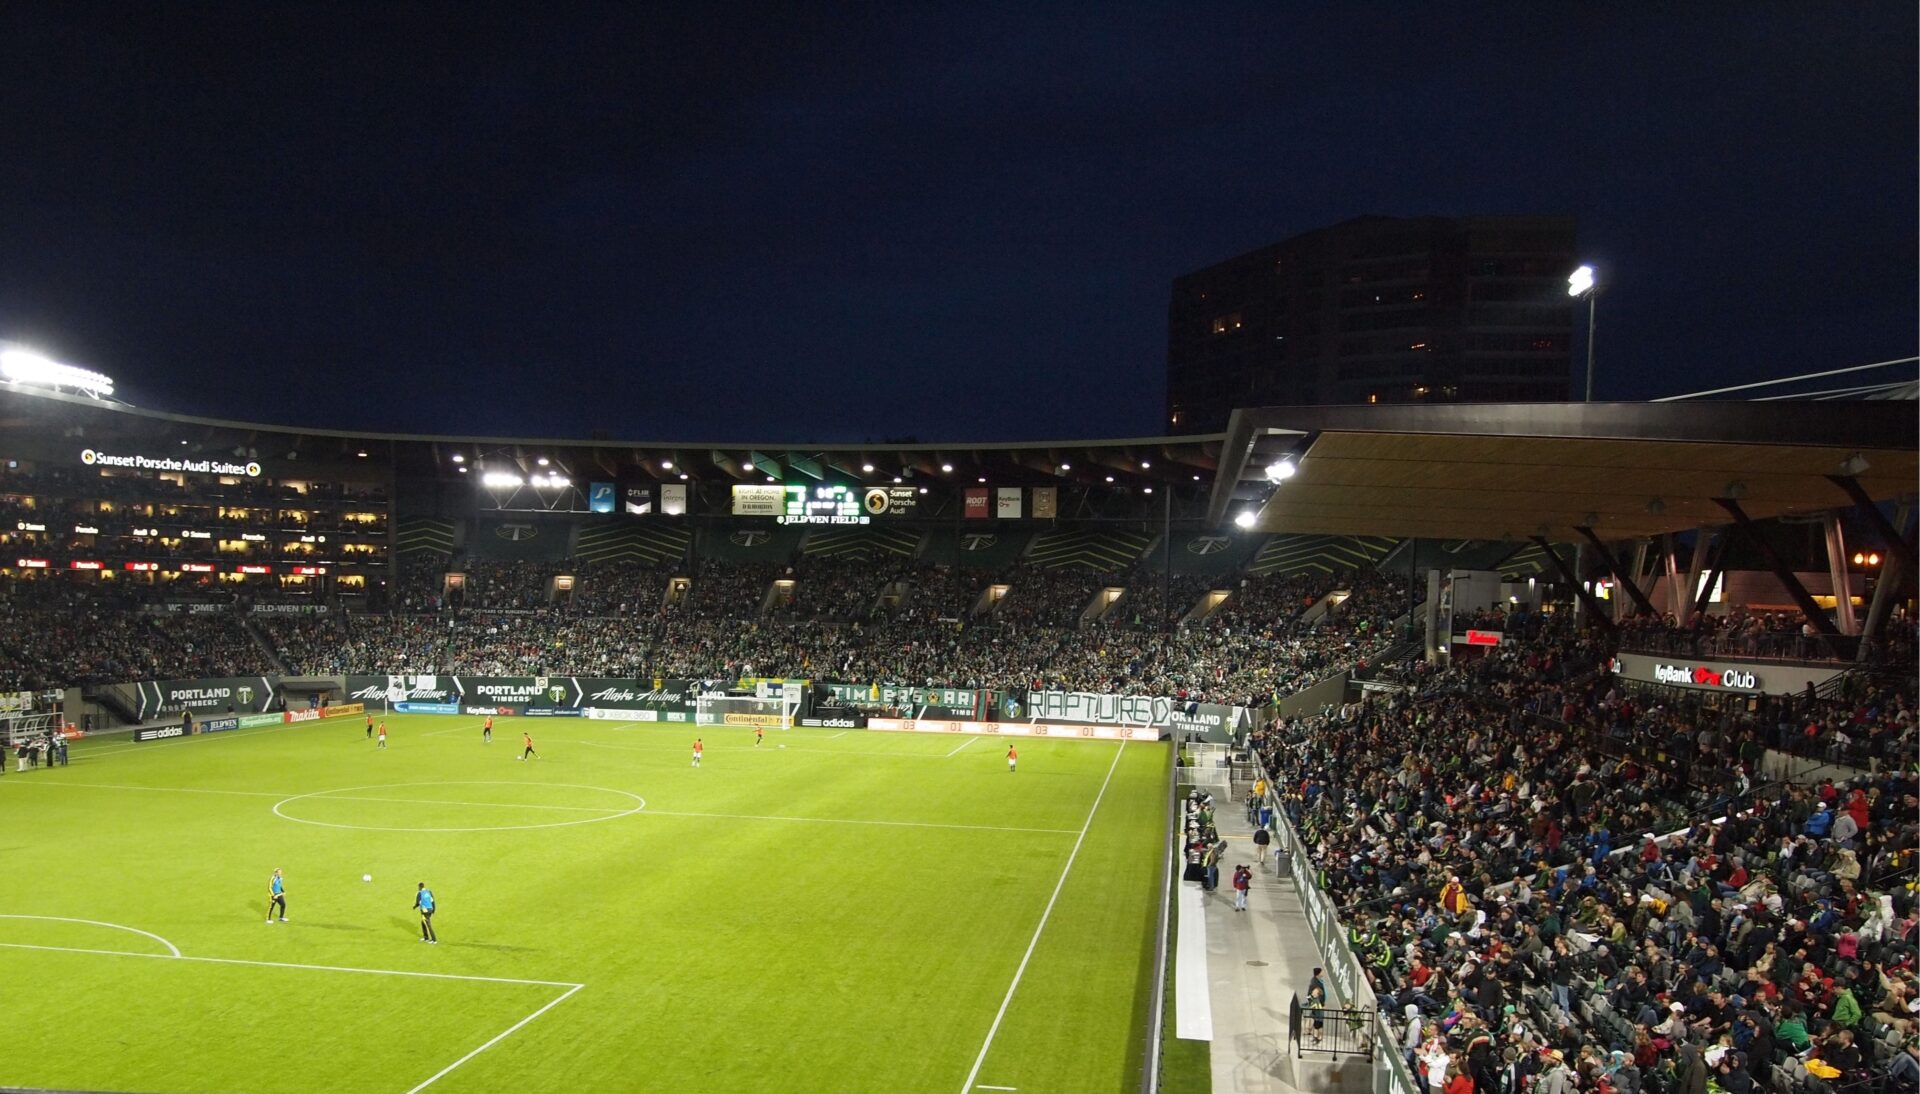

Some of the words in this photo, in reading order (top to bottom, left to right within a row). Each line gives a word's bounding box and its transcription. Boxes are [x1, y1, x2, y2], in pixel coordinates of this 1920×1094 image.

[96, 452, 135, 467] Sunset
[136, 456, 182, 471] Porsche
[183, 460, 210, 472] Audi
[211, 462, 245, 475] Suites
[889, 489, 913, 497] Sunset
[831, 515, 859, 524] FIELD
[252, 604, 299, 613] JELD-WEN
[301, 604, 328, 613] FLD
[1655, 664, 1693, 683] KeyBank
[1723, 669, 1755, 689] Club
[171, 688, 230, 700] PORTLAND
[351, 685, 389, 701] Alask
[477, 685, 543, 696] PORTLAND
[590, 687, 635, 702] Alaska
[637, 688, 681, 703] Airlines
[183, 700, 218, 708] TIMBERS
[1029, 691, 1169, 724] RAPTURED
[289, 708, 320, 722] Makita
[466, 706, 497, 715] KeyBank
[951, 708, 974, 716] TIMB
[725, 713, 768, 724] Continental
[823, 718, 855, 728] adidas
[1171, 711, 1220, 726] ORLAND
[157, 726, 183, 738] adidas
[903, 721, 916, 730] 03
[950, 722, 962, 731] 01
[986, 724, 1000, 733] 02
[1035, 725, 1048, 735] 03
[1082, 727, 1095, 737] 01
[1120, 729, 1133, 738] 02
[1177, 723, 1209, 733] TIMBERS
